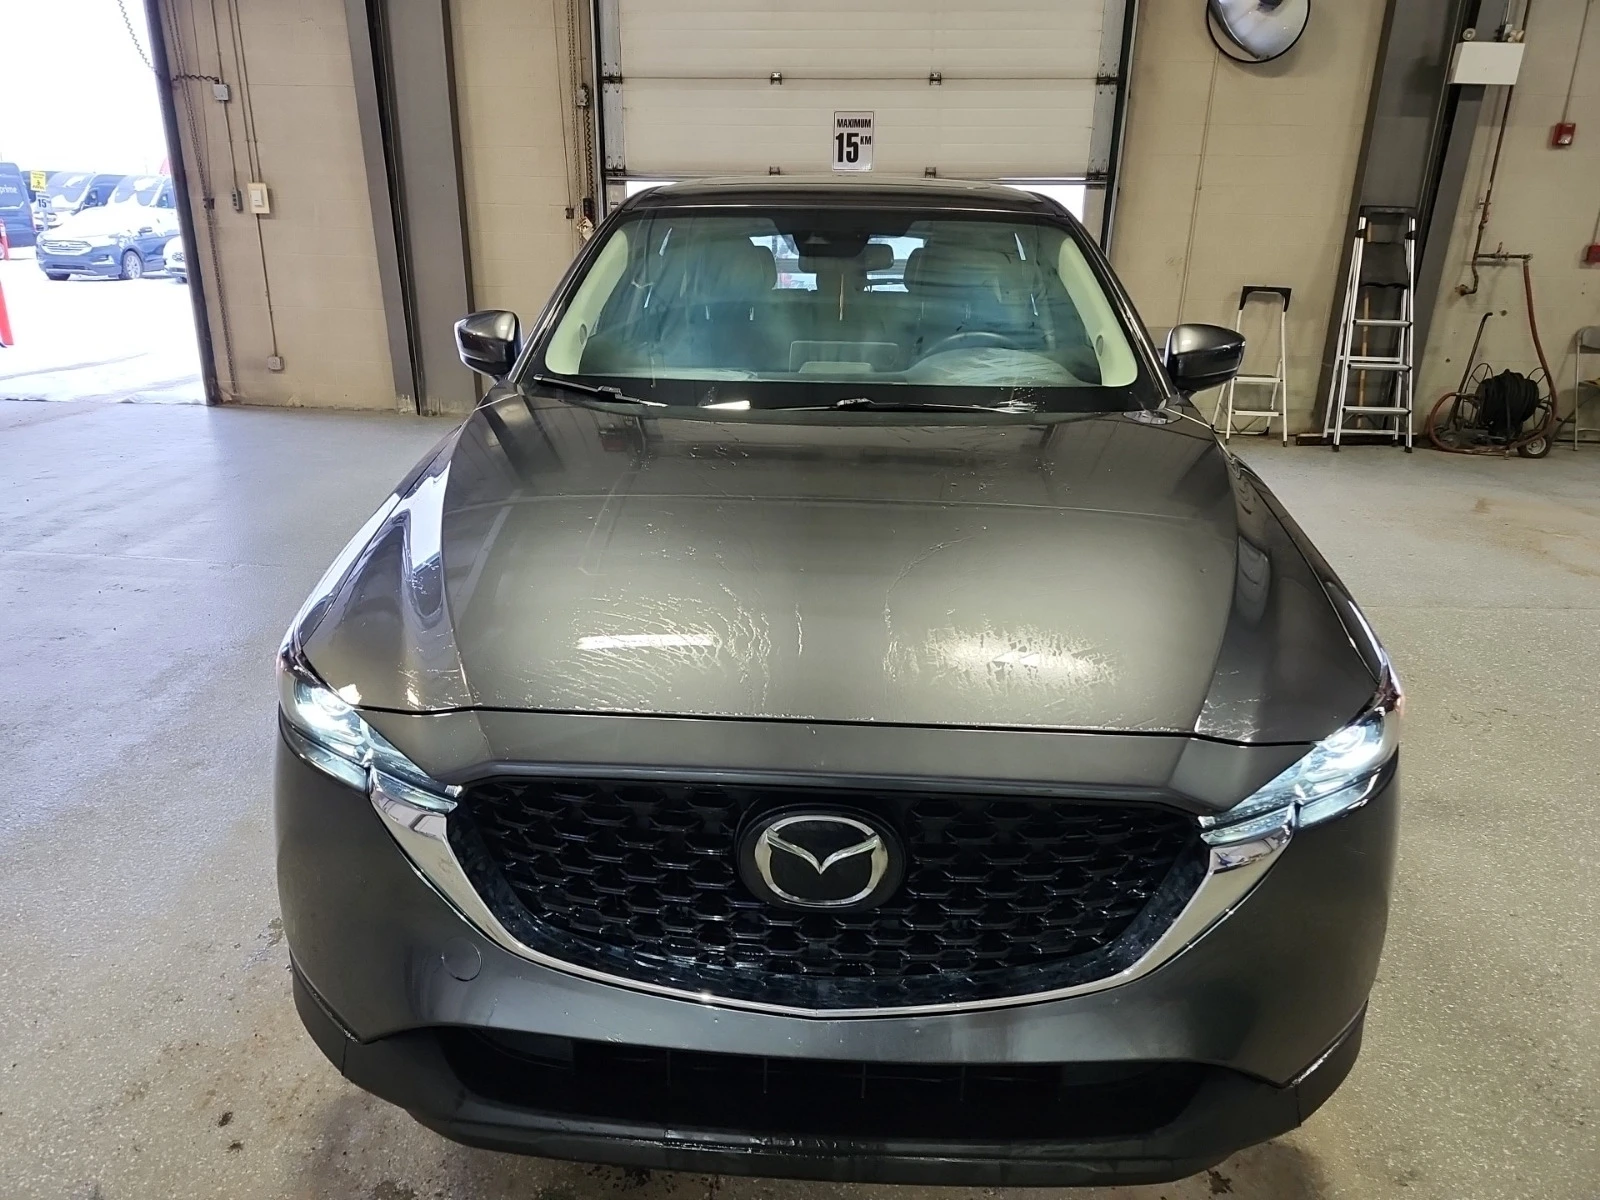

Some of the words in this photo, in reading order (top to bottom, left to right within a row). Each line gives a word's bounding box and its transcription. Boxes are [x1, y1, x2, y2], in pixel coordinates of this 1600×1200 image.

[836, 118, 872, 129] MAXIMUM
[836, 132, 860, 163] 15
[860, 135, 872, 145] KM
[38, 199, 47, 208] 15
